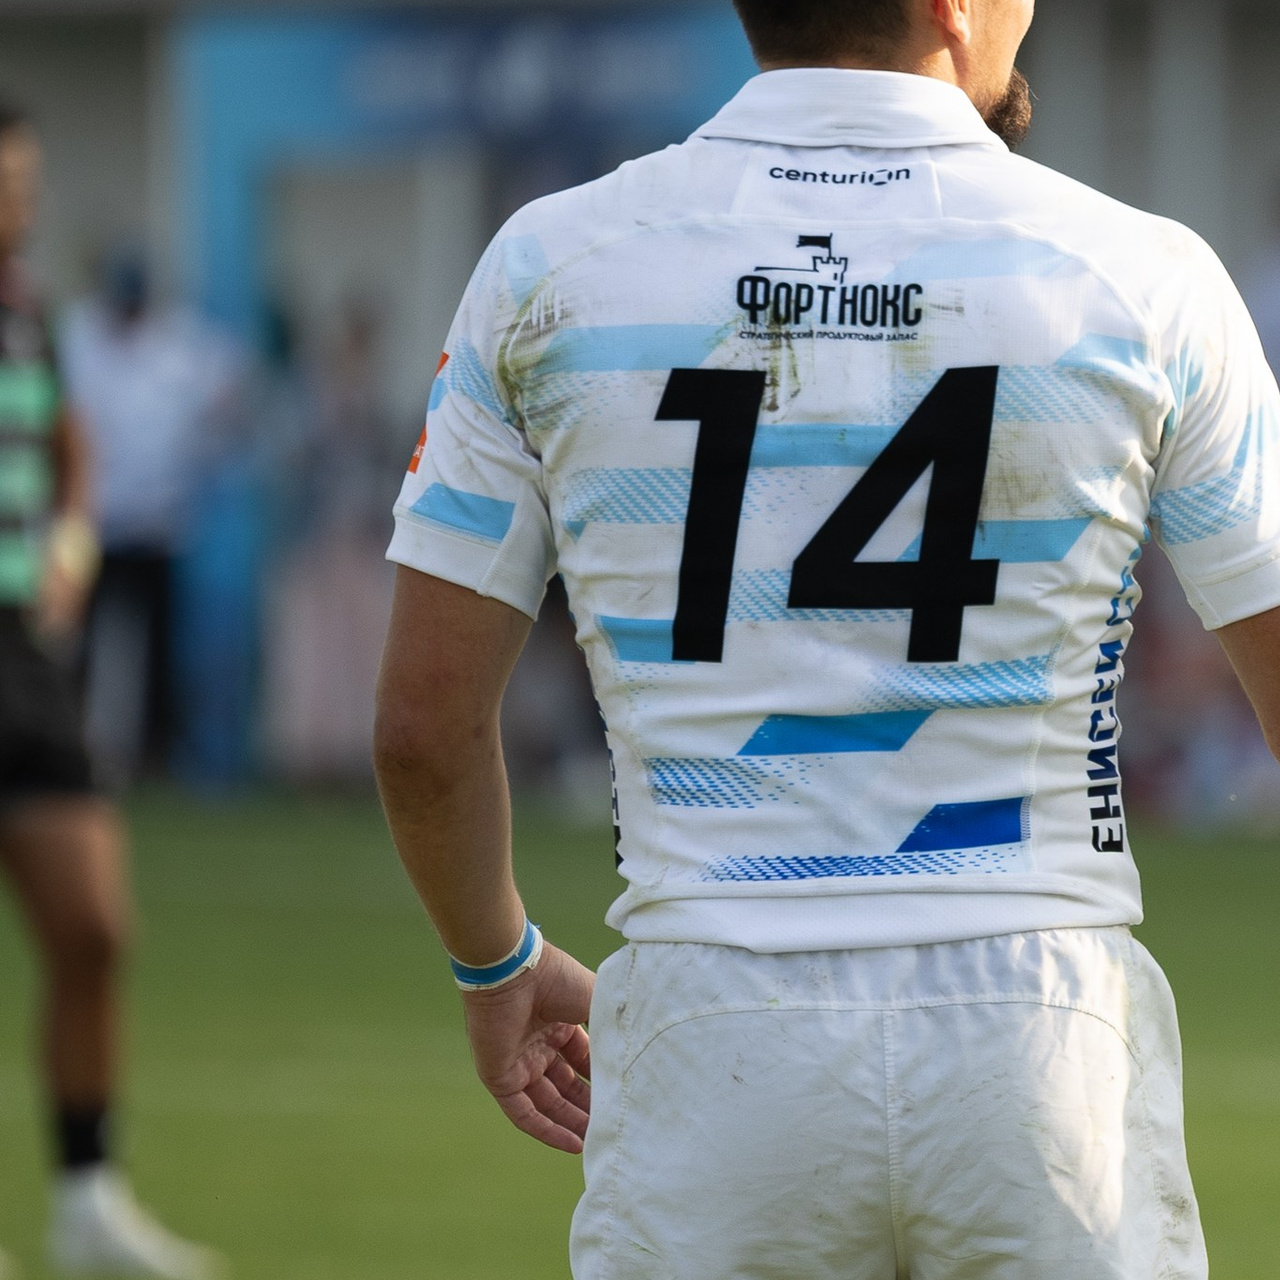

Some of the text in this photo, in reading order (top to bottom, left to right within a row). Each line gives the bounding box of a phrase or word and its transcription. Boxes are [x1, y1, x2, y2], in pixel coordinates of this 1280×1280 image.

[768, 167, 911, 186] centurion
[736, 275, 923, 328] ФОРТНОКС
[654, 365, 1000, 663] 14
